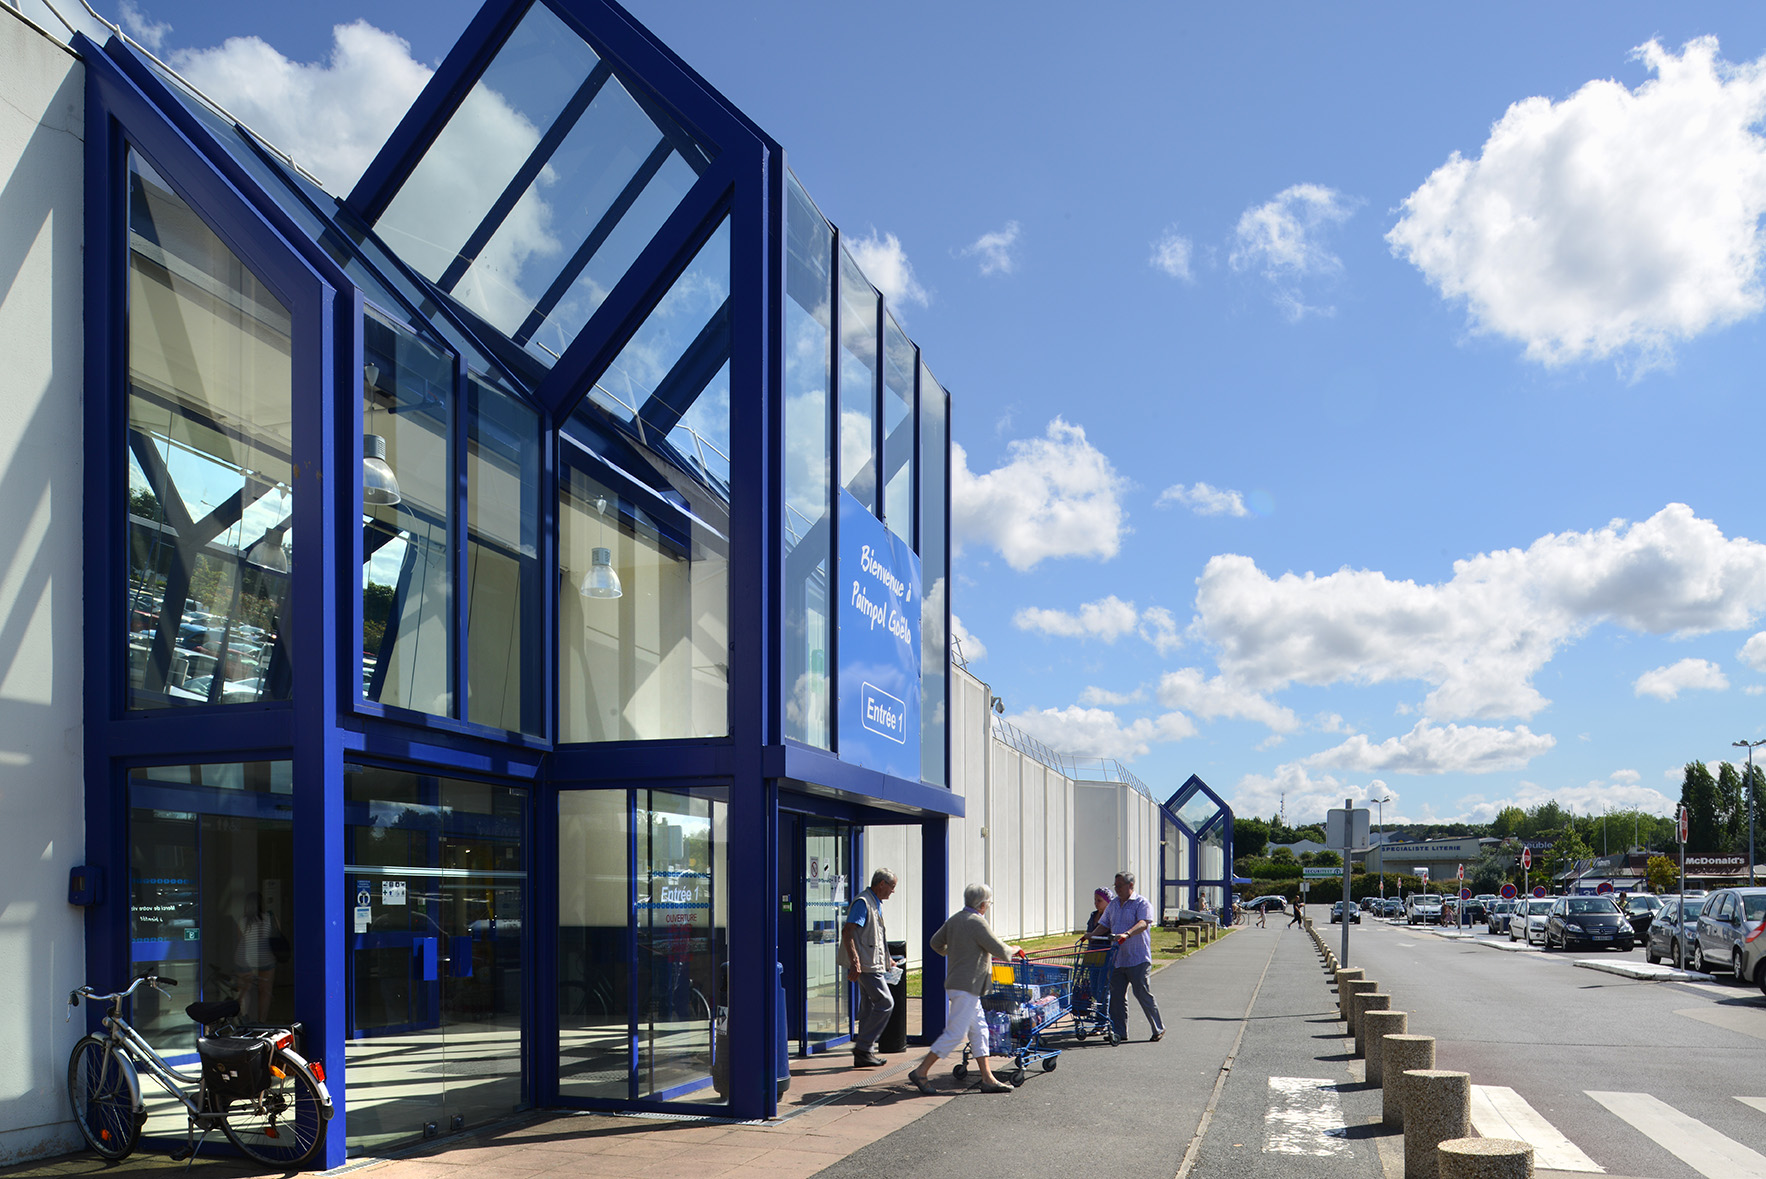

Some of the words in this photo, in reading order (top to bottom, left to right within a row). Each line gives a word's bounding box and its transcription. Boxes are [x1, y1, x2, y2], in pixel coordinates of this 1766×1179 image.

[861, 545, 904, 597] Bienvenue
[906, 582, 911, 602] à
[852, 580, 887, 630] Paimpol
[888, 609, 911, 644] Goëlo
[867, 697, 896, 730] Entrée
[898, 712, 903, 733] 1
[1685, 857, 1745, 865] McDonald's
[661, 885, 692, 903] Entrée
[694, 886, 699, 901] 1
[666, 914, 697, 923] OUVERTURE
